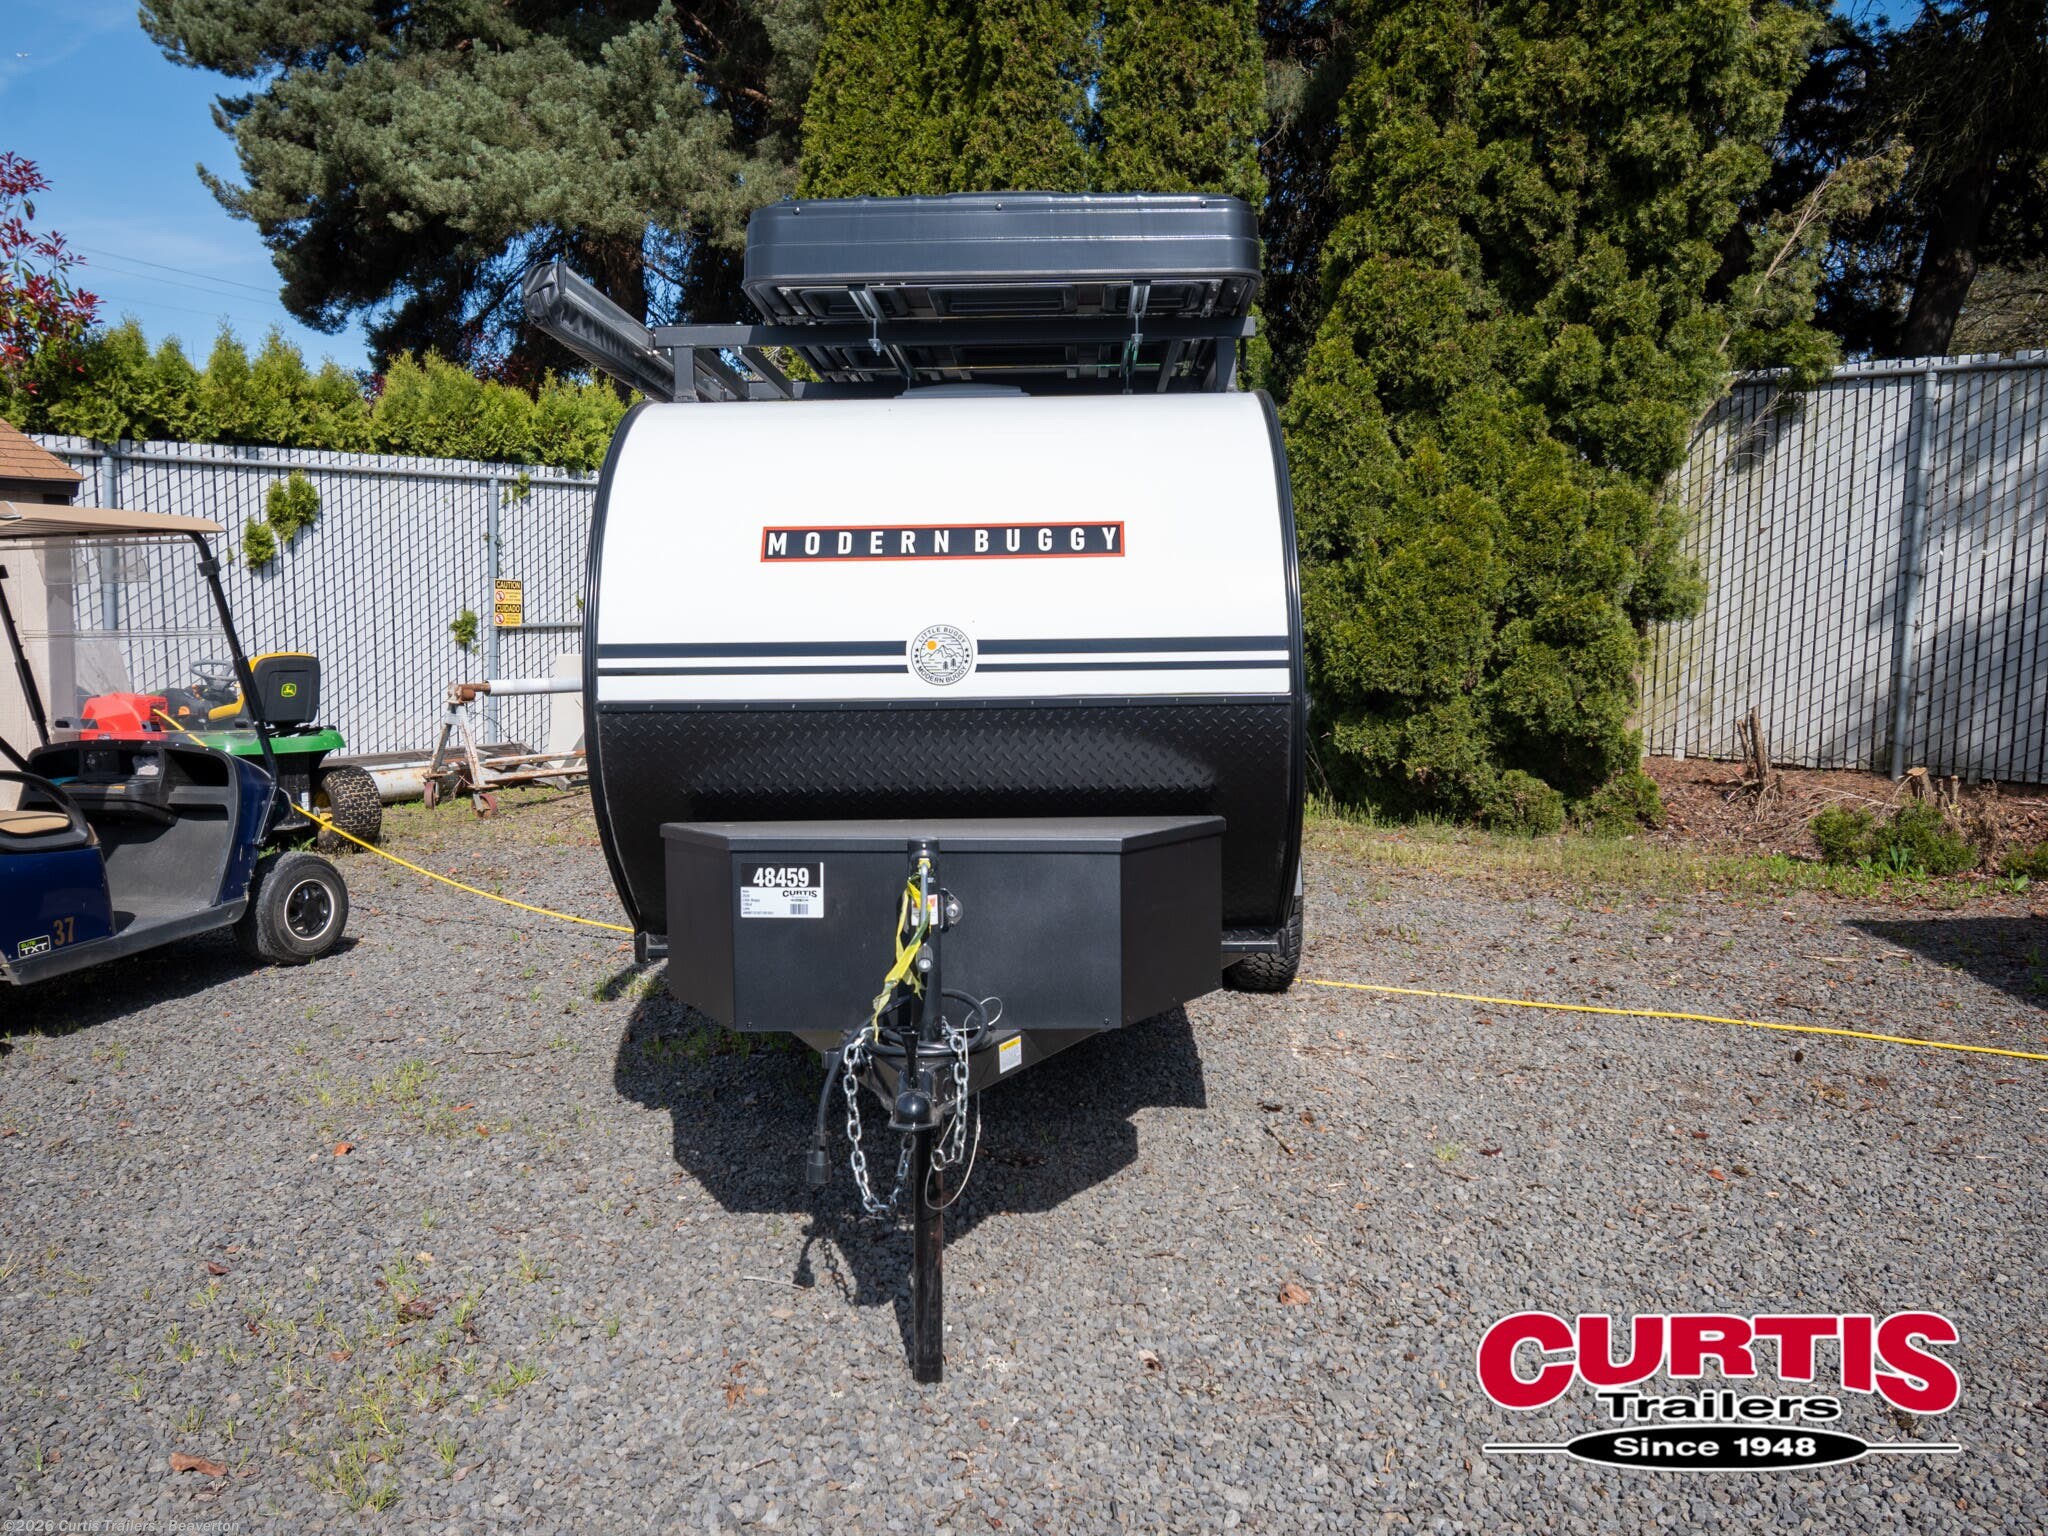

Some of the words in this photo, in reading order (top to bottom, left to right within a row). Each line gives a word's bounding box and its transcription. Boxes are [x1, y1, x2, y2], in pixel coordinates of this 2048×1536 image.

[767, 530, 949, 555] MODERN
[974, 527, 1117, 553] BUGGY
[496, 581, 520, 589] CAUTION
[918, 627, 941, 643] LITTLE
[943, 627, 967, 643] BUGGY
[918, 665, 945, 683] MODERN
[945, 665, 967, 683] BUGGY
[753, 867, 810, 888] 48459
[782, 890, 818, 898] CURTIS
[53, 916, 75, 946] 37
[20, 942, 48, 955] TXT
